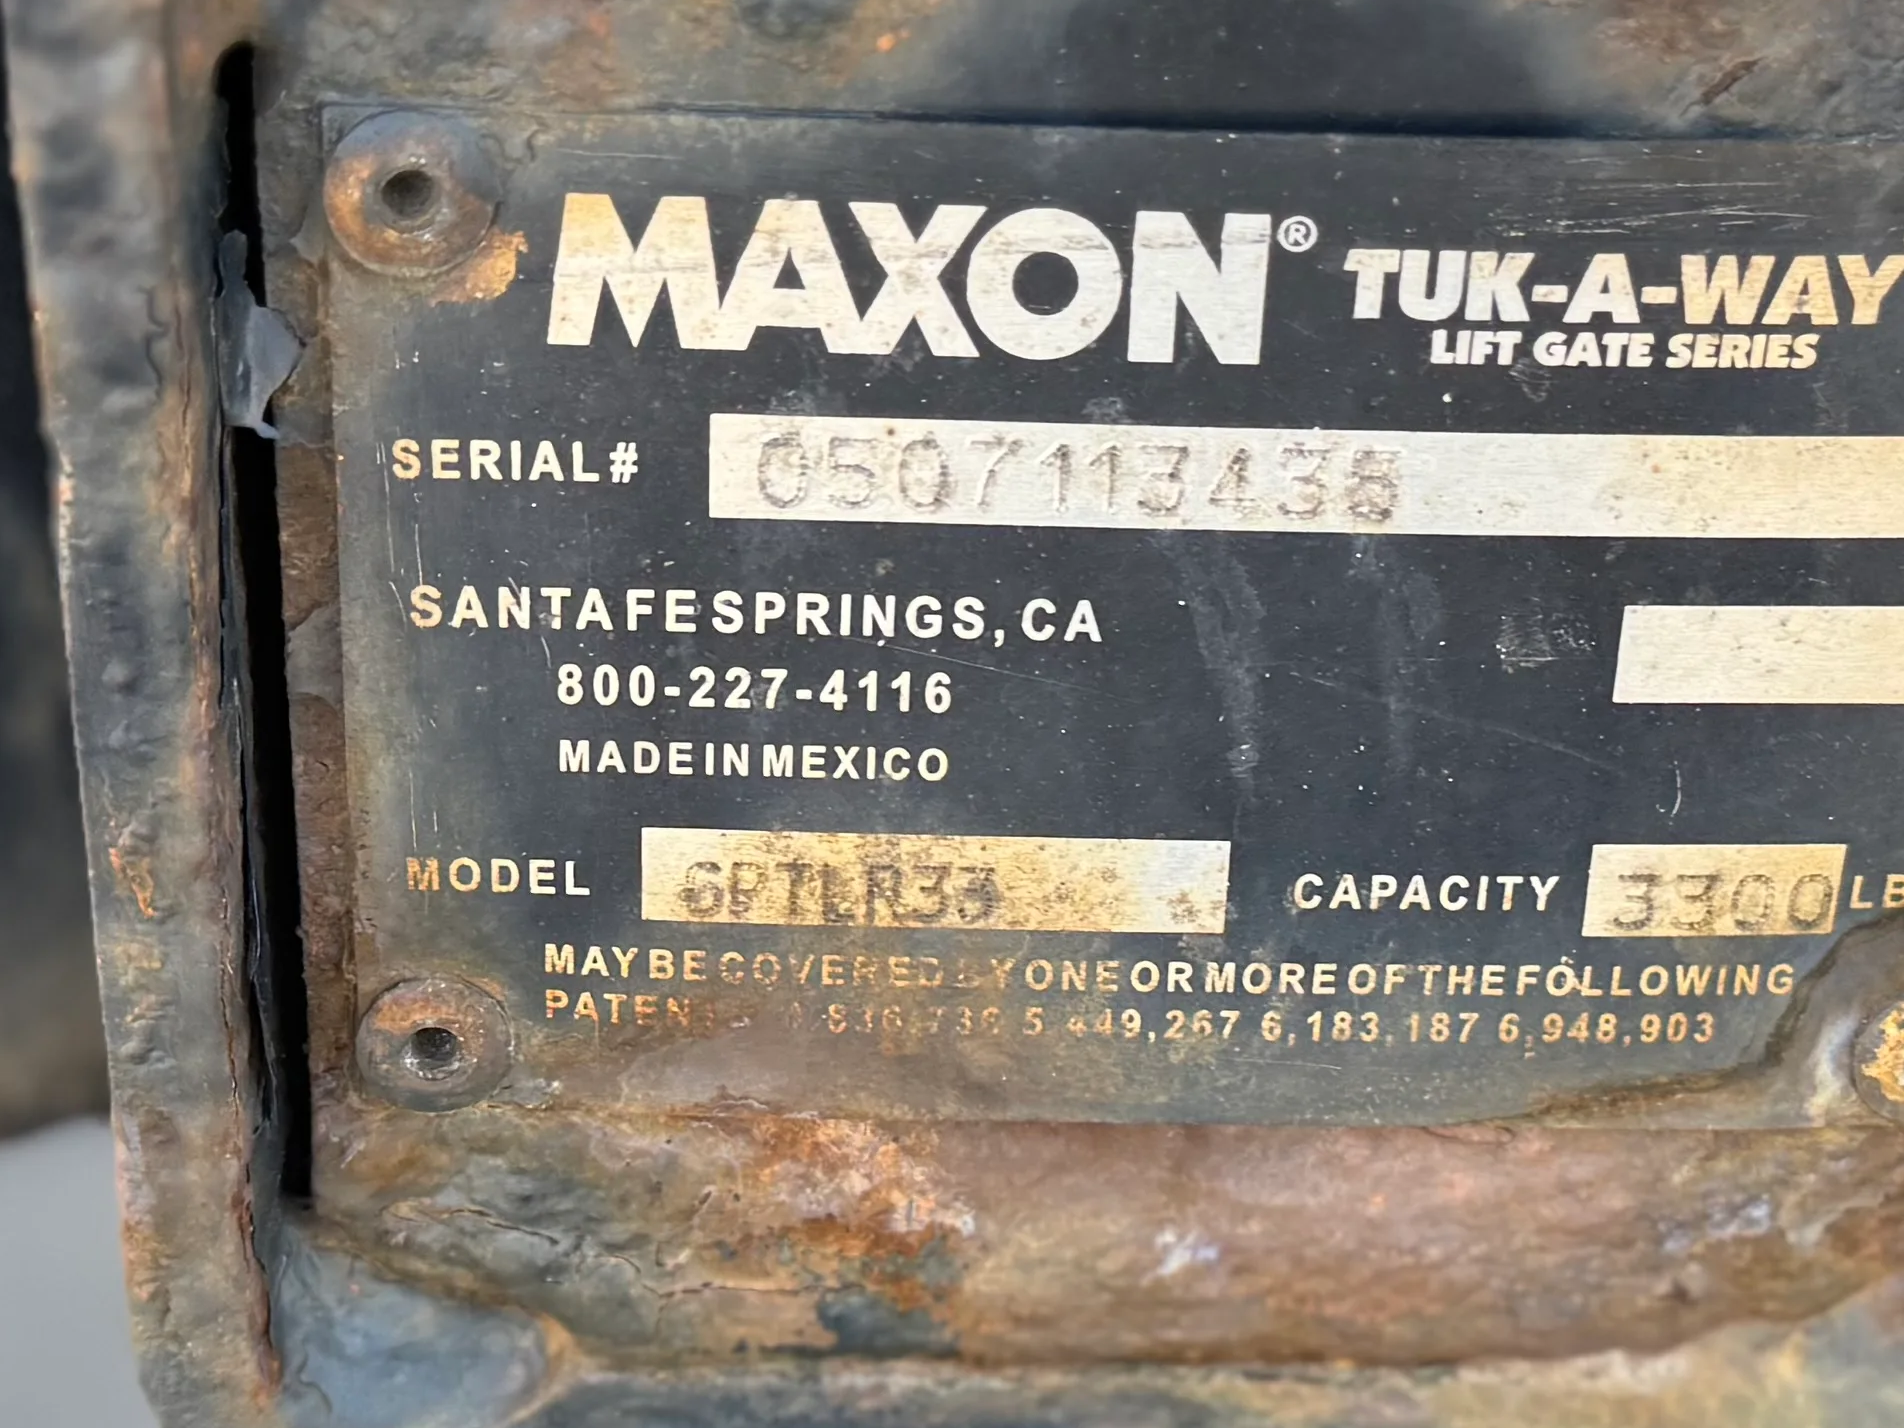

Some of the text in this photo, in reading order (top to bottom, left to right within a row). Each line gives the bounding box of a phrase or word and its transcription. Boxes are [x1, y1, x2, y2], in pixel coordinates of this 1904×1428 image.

[1430, 329, 1820, 369] LIFT GATE SERIES
[392, 438, 639, 484] SERIAL#
[1020, 598, 1103, 642] CA
[557, 664, 951, 714] 800-227-4116
[407, 858, 590, 896] MODEL
[1293, 874, 1560, 910] CAPACITY
[1610, 872, 1834, 931] 3300
[544, 943, 639, 979] MAY
[648, 948, 708, 982] BE
[718, 951, 946, 987] COVERED
[1024, 959, 1121, 992] ONE
[1129, 960, 1194, 994] OR
[1203, 962, 1336, 995] MORE
[1347, 963, 1408, 996] OF
[1417, 964, 1505, 996] THE
[1515, 964, 1794, 997] FOLLOWING
[1260, 1011, 1480, 1047] 6,183,187
[1497, 1012, 1714, 1048] 6,948,903
